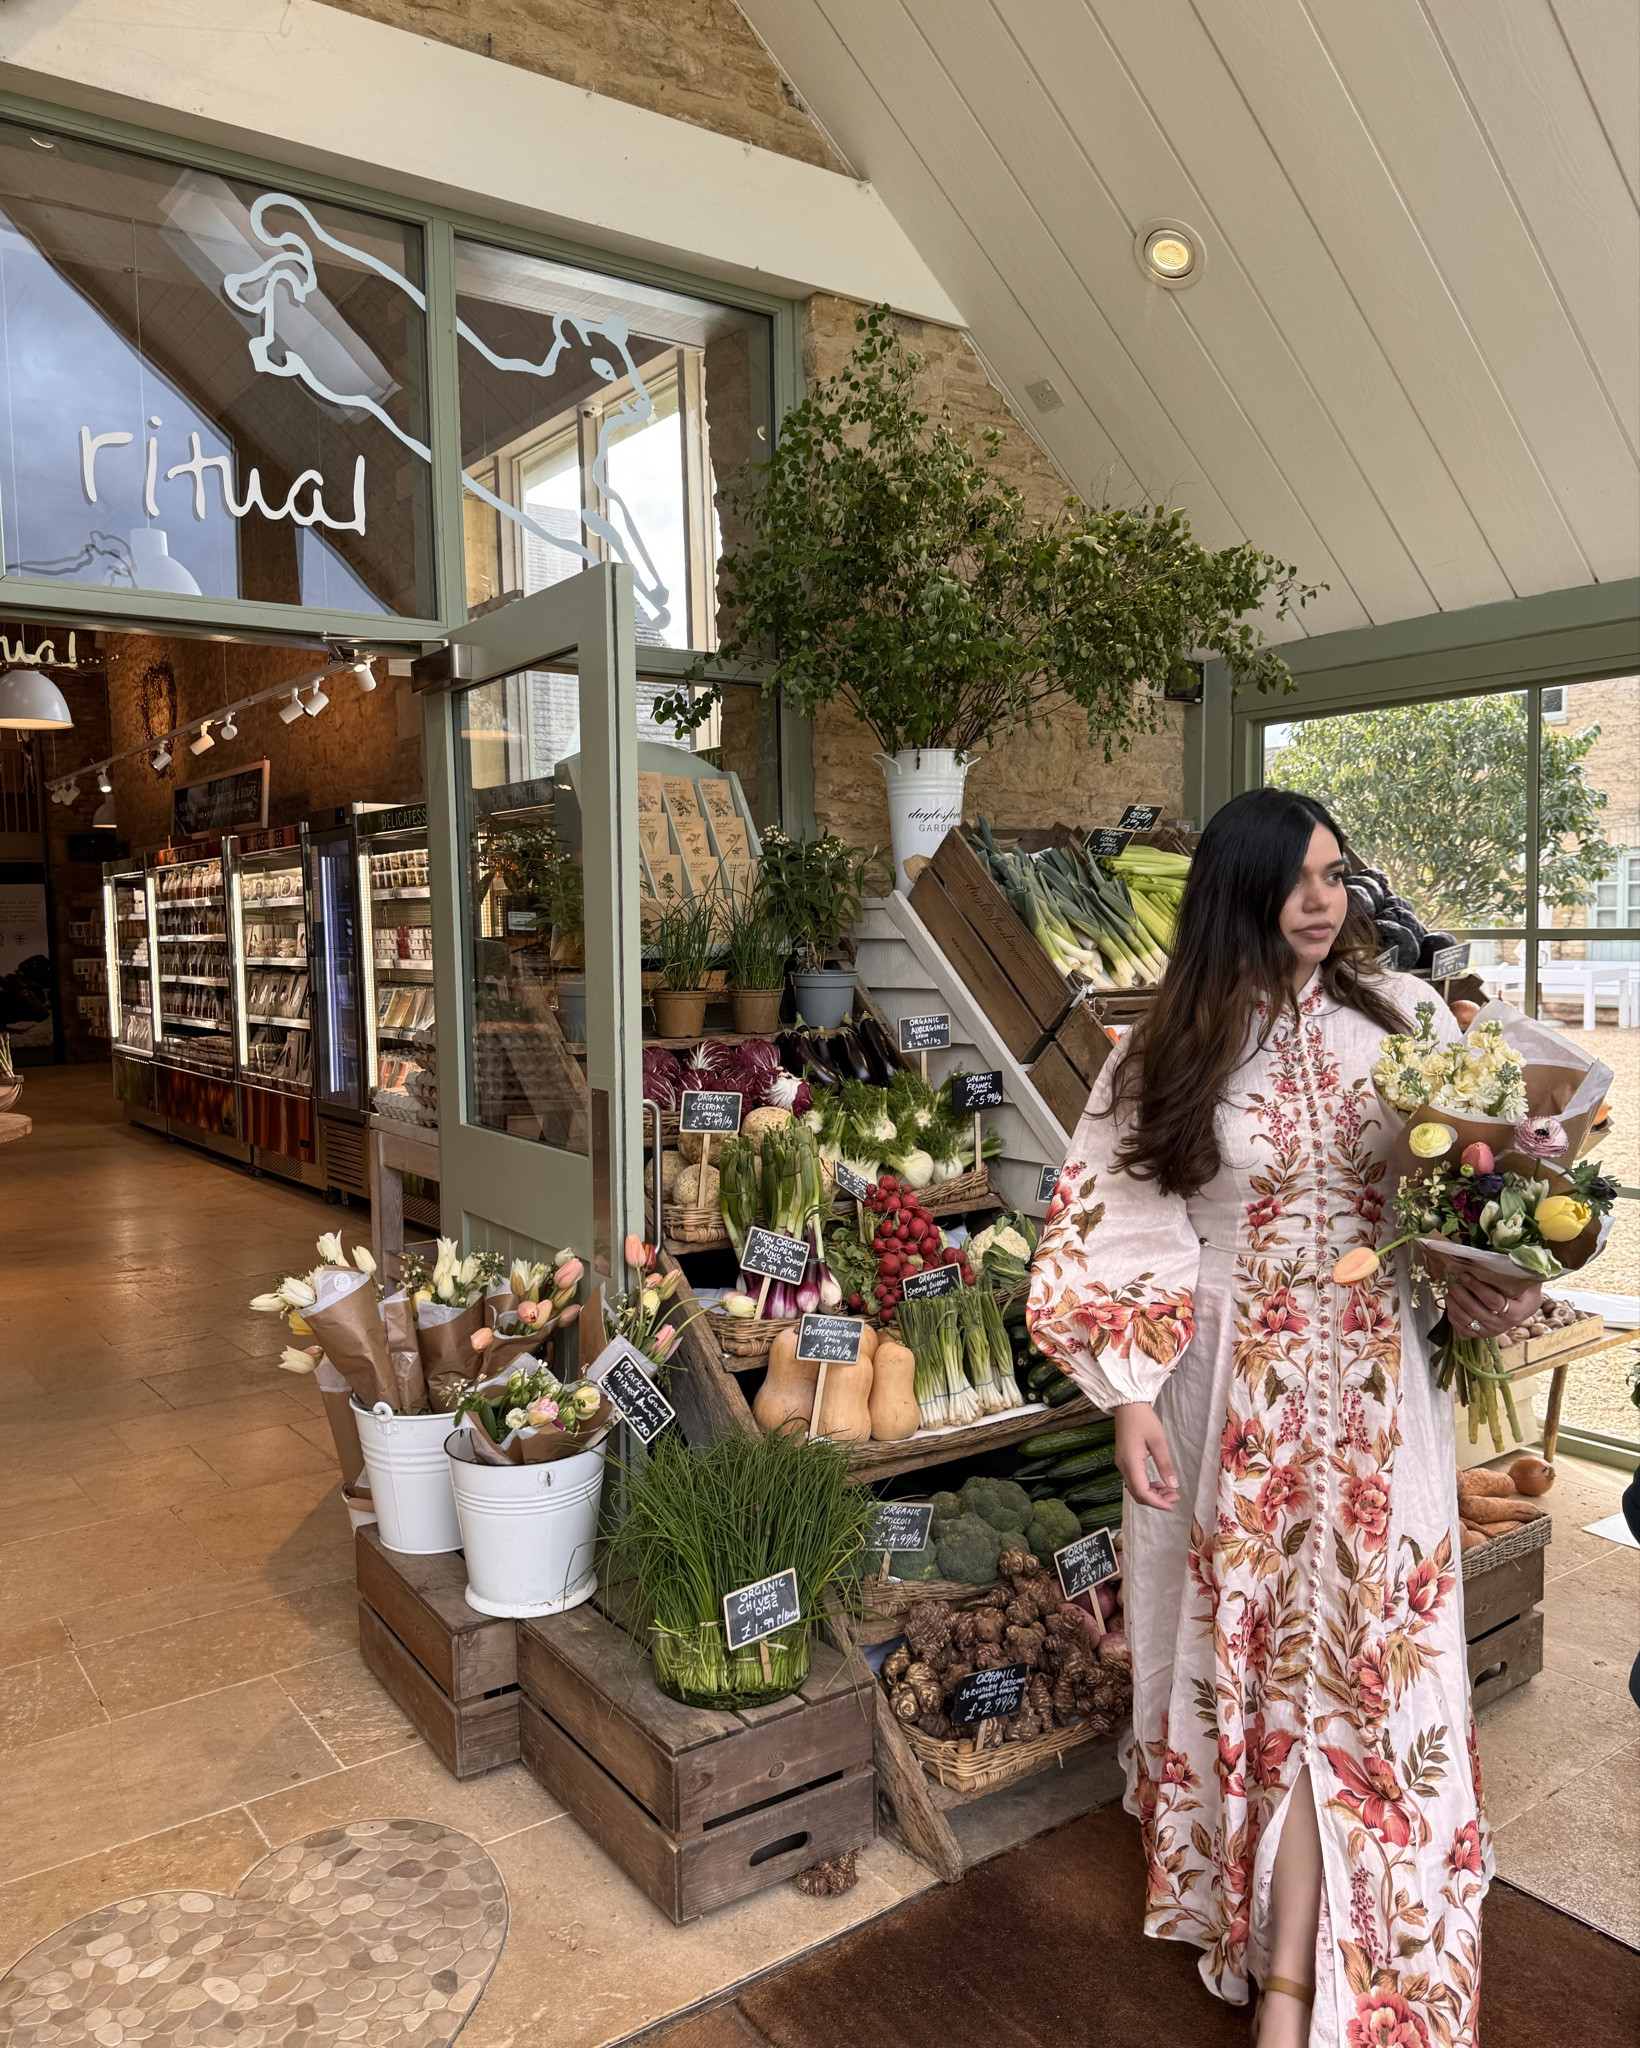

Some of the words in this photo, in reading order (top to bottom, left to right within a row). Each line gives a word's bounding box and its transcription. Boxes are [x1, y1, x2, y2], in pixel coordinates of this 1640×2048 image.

[82, 415, 366, 537] ritual
[0, 631, 78, 668] ual
[918, 824, 955, 832] GARDE
[909, 1017, 940, 1027] ORGANIC
[910, 1023, 949, 1035] AUBERGINES
[965, 1073, 993, 1083] ORGANIC
[966, 1081, 993, 1092] FENNEL
[697, 1092, 733, 1104] ORGANIC
[756, 1231, 776, 1244] NON
[776, 1238, 808, 1254] ORGANIC
[763, 1240, 794, 1257] TROPEA
[753, 1245, 783, 1260] SPRING
[918, 1270, 947, 1285] ORGANIC
[817, 1318, 850, 1329] ORGANIC
[619, 1360, 652, 1396] Market
[629, 1415, 651, 1437] £20
[883, 1505, 922, 1516] ORGANIC
[1067, 1536, 1100, 1558] ORGANIC
[739, 1578, 786, 1603] ORGANIC
[755, 1600, 779, 1616] DMG
[975, 1668, 1017, 1685] ORGANIC
